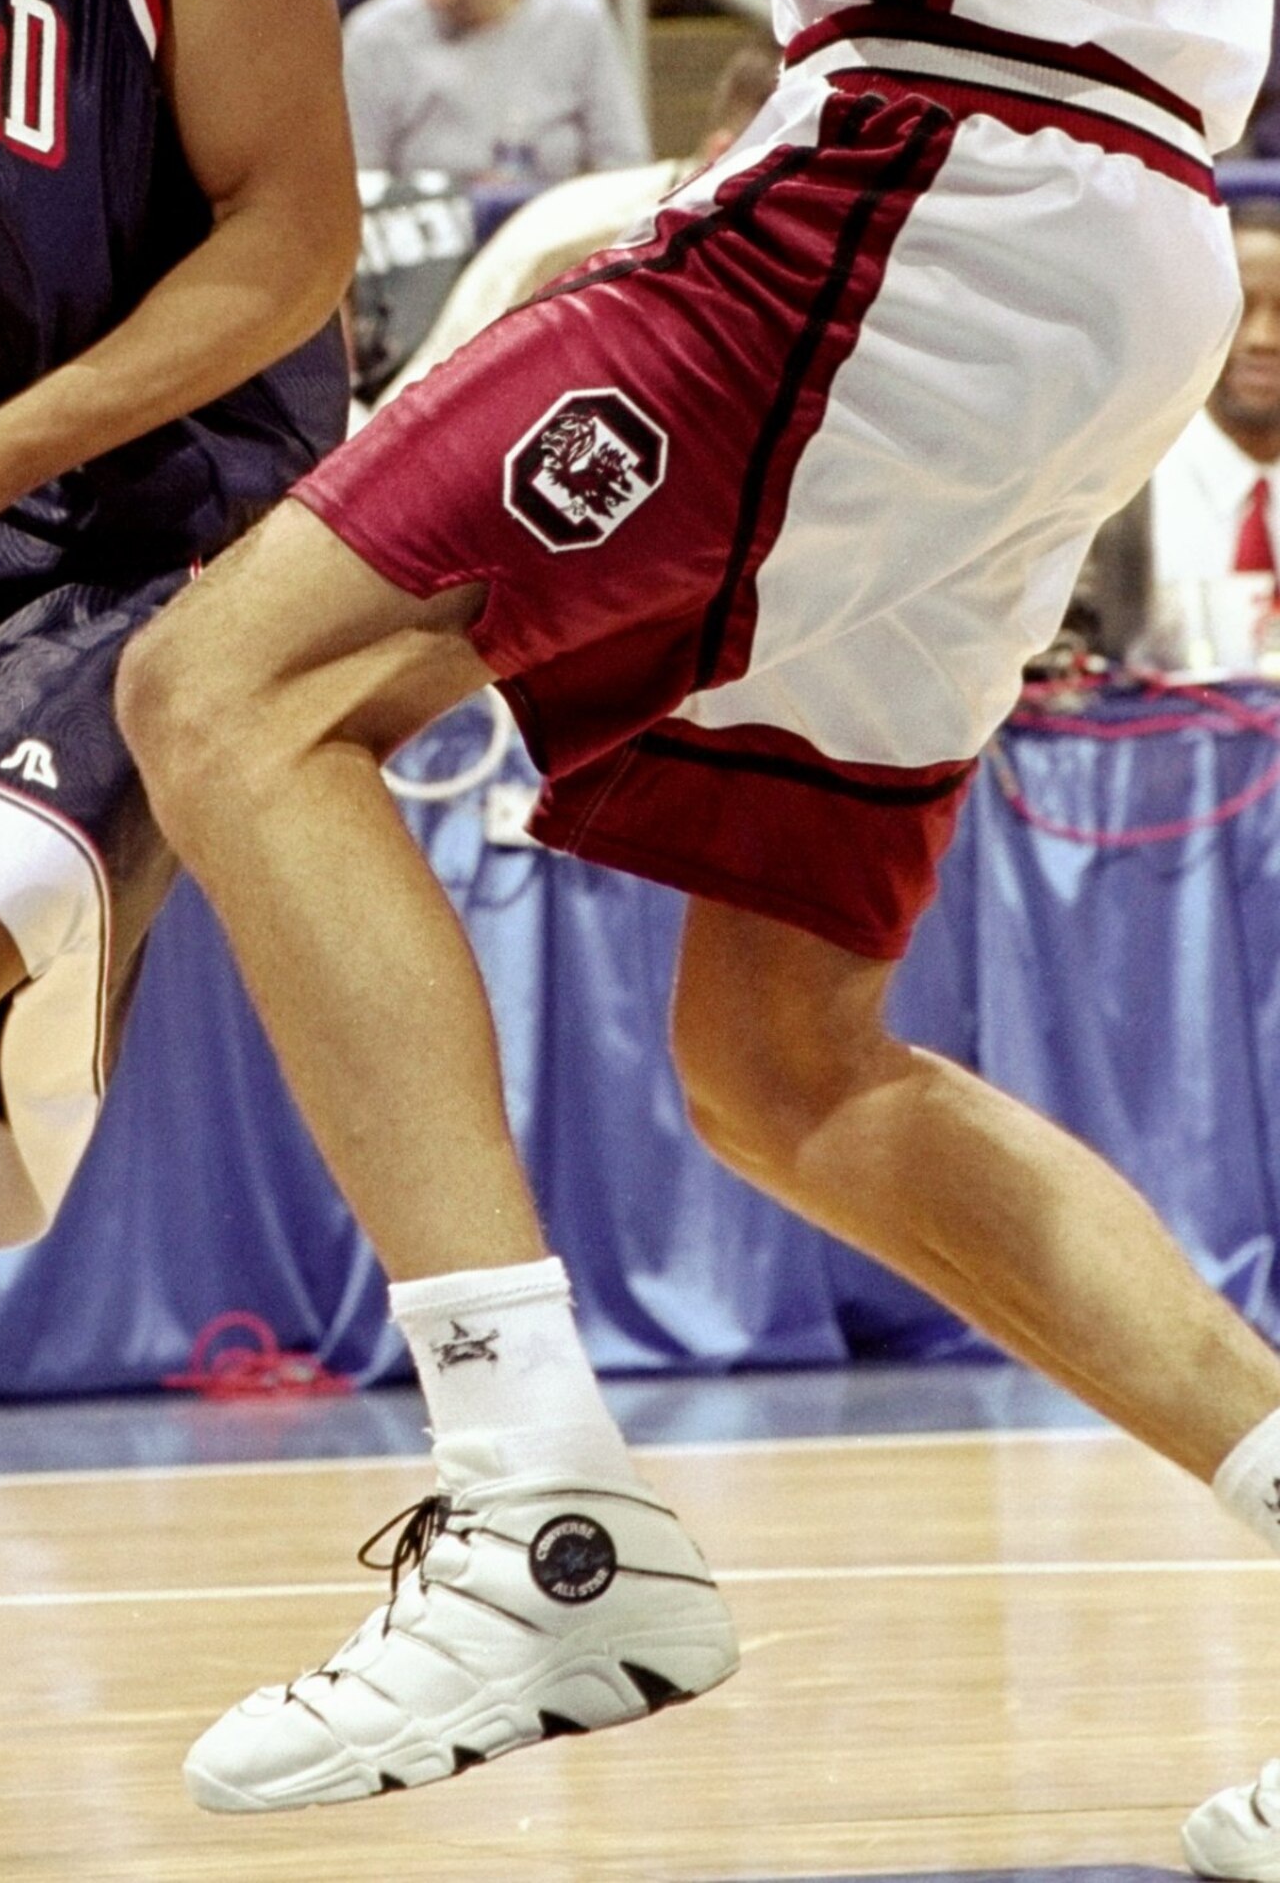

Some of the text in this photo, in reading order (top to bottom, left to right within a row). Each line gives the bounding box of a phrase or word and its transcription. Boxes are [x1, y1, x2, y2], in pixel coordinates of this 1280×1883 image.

[535, 1521, 597, 1562] CONVERSE
[550, 1567, 609, 1598] ALL STAR
